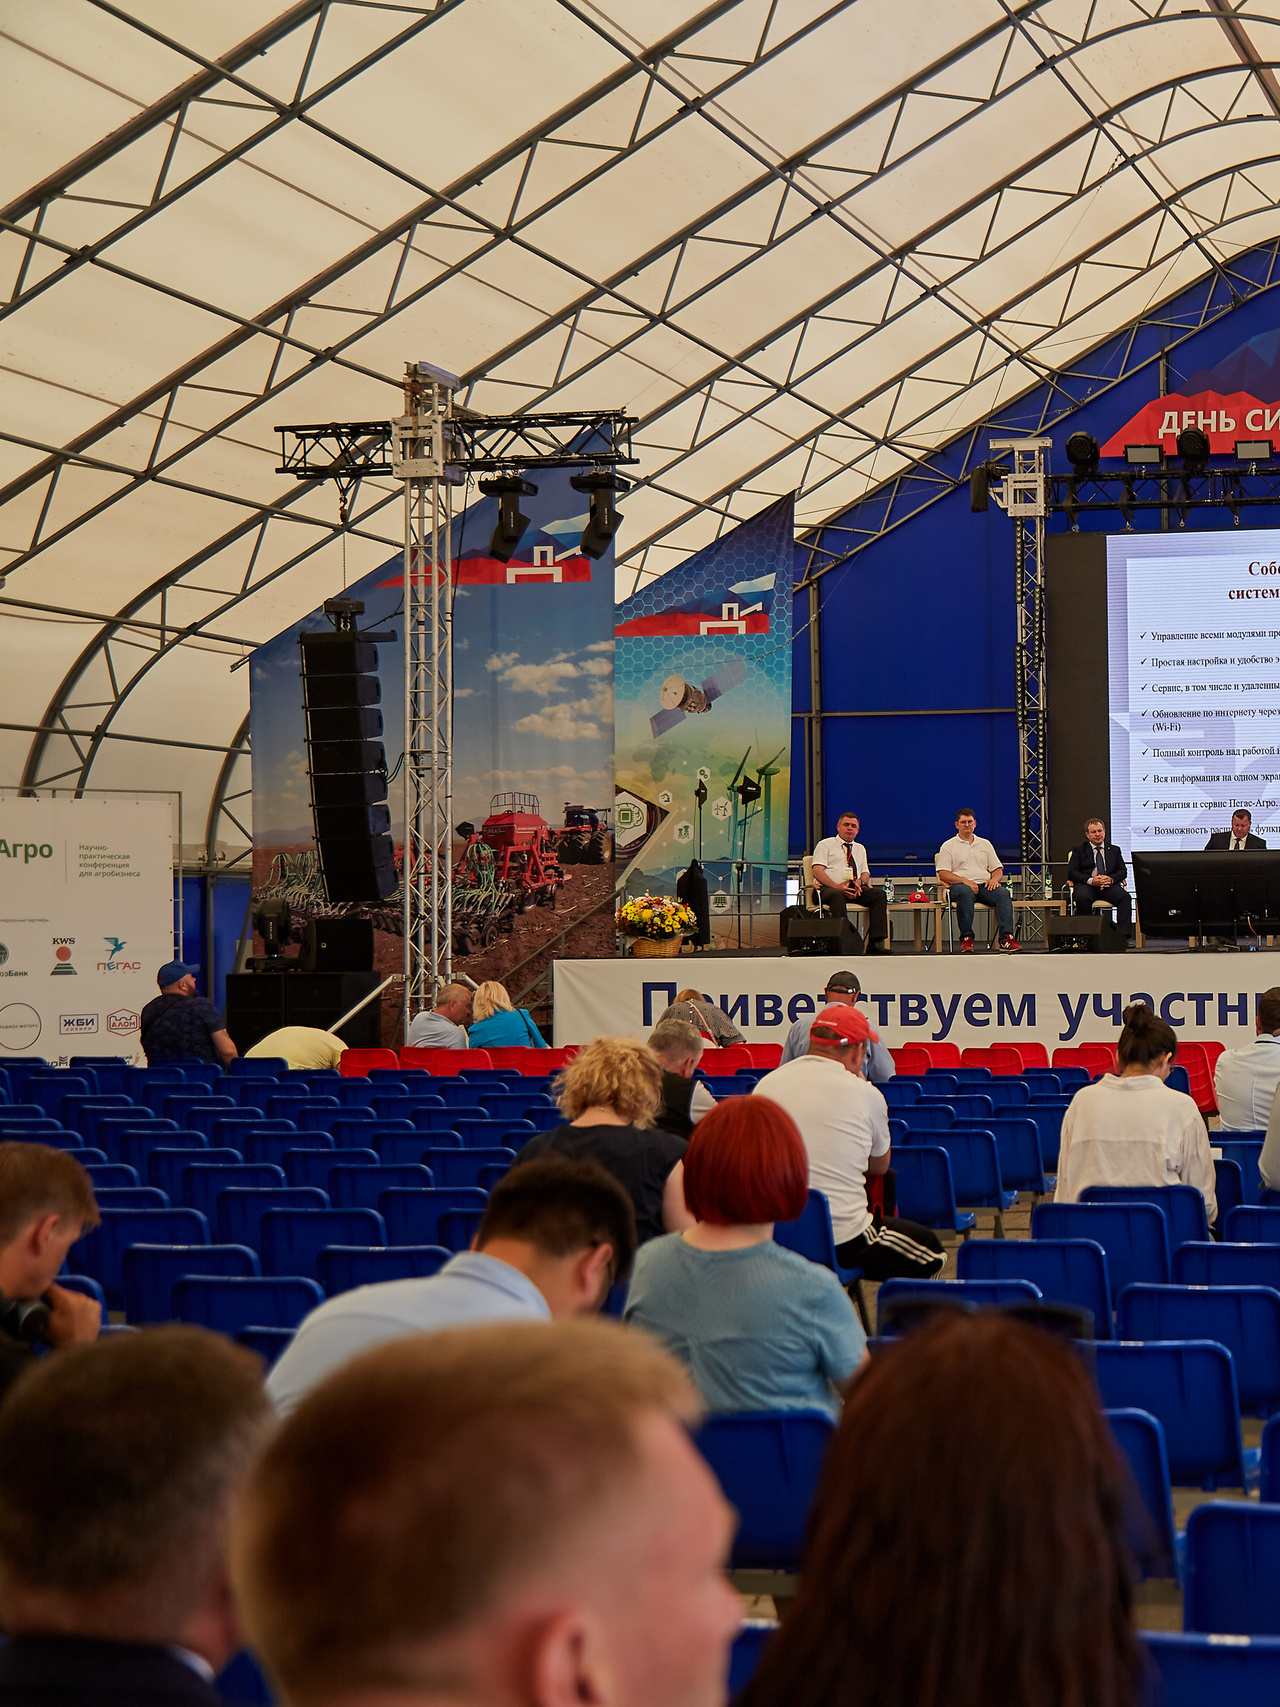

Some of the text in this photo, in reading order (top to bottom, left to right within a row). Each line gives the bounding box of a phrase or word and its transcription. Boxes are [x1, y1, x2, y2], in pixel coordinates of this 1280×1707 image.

[1158, 410, 1236, 439] ДЕНЬ
[1151, 632, 1199, 643] Управление
[1200, 631, 1225, 639] всеми
[1226, 630, 1266, 640] модулями
[1151, 658, 1185, 668] Простая
[1187, 656, 1228, 667] настройка
[1237, 654, 1274, 666] удобство
[1151, 683, 1184, 694] Сервис,
[1192, 684, 1207, 692] том
[1208, 683, 1232, 691] числе
[1152, 709, 1201, 719] Обновление
[1203, 709, 1213, 717] по
[1215, 708, 1256, 718] интернету
[1258, 708, 1280, 718] через
[1152, 722, 1181, 733] (Wi-Fi)
[1152, 747, 1186, 758] Полный
[1187, 748, 1224, 758] контроль
[1226, 748, 1240, 756] над
[1242, 746, 1275, 757] работой
[1153, 774, 1168, 783] Вся
[1170, 773, 1220, 784] информация
[1222, 773, 1232, 782] на
[1233, 773, 1259, 782] одном
[1153, 800, 1190, 811] Гарантия
[1199, 800, 1227, 810] сервис
[1229, 798, 1278, 809] Пегас-Агро.
[1154, 826, 1208, 835] Возможность
[0, 838, 54, 864] Агро
[79, 844, 109, 852] Научно-
[79, 862, 130, 870] конференция
[94, 869, 141, 878] агробизнеса
[52, 937, 76, 945] KWS
[96, 961, 142, 971] ПЕГАС
[642, 981, 1037, 1041] Пиветвуем
[63, 1017, 95, 1028] ЖБИ
[111, 1020, 136, 1028] АЛОМ
